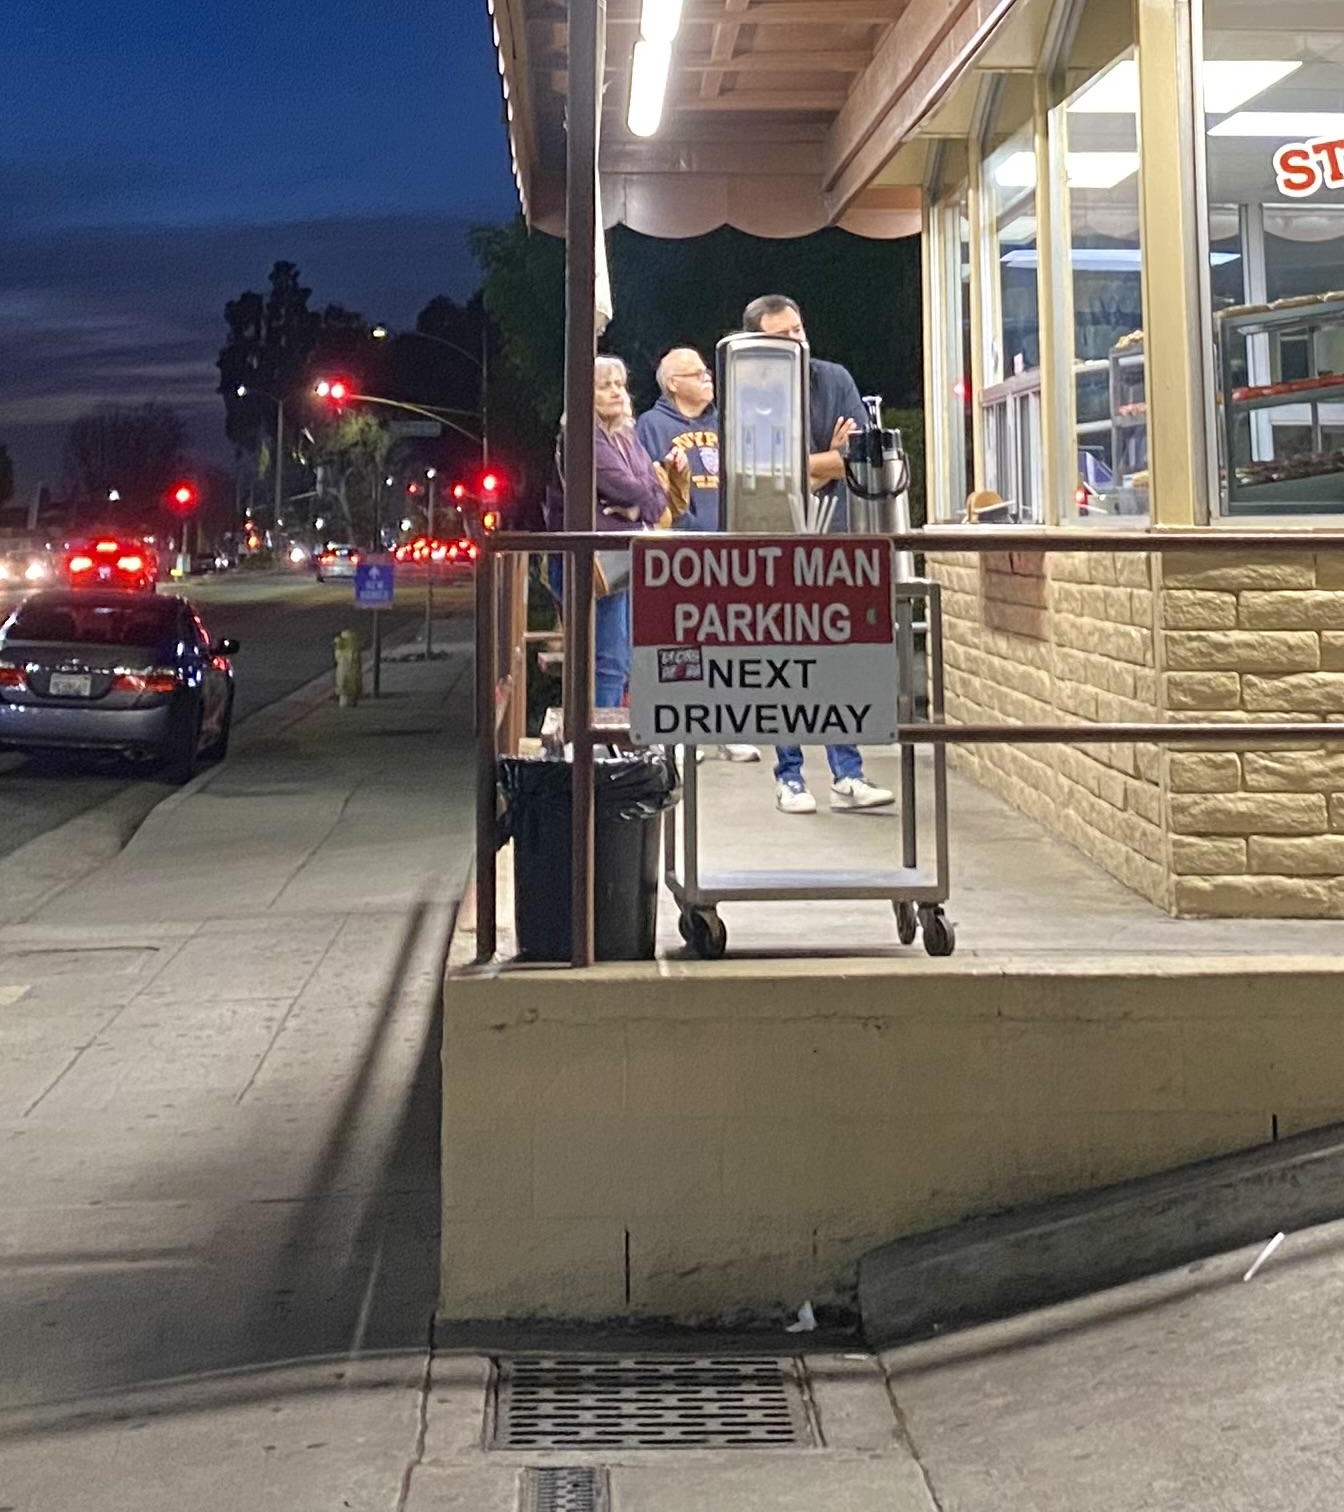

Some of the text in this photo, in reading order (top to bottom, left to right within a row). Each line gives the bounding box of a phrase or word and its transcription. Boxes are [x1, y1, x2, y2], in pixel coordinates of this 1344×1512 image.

[644, 547, 881, 587] DONUT MAN
[674, 602, 851, 643] PARKING
[708, 659, 817, 688] NEXT
[654, 704, 872, 734] DRIVEWAY
